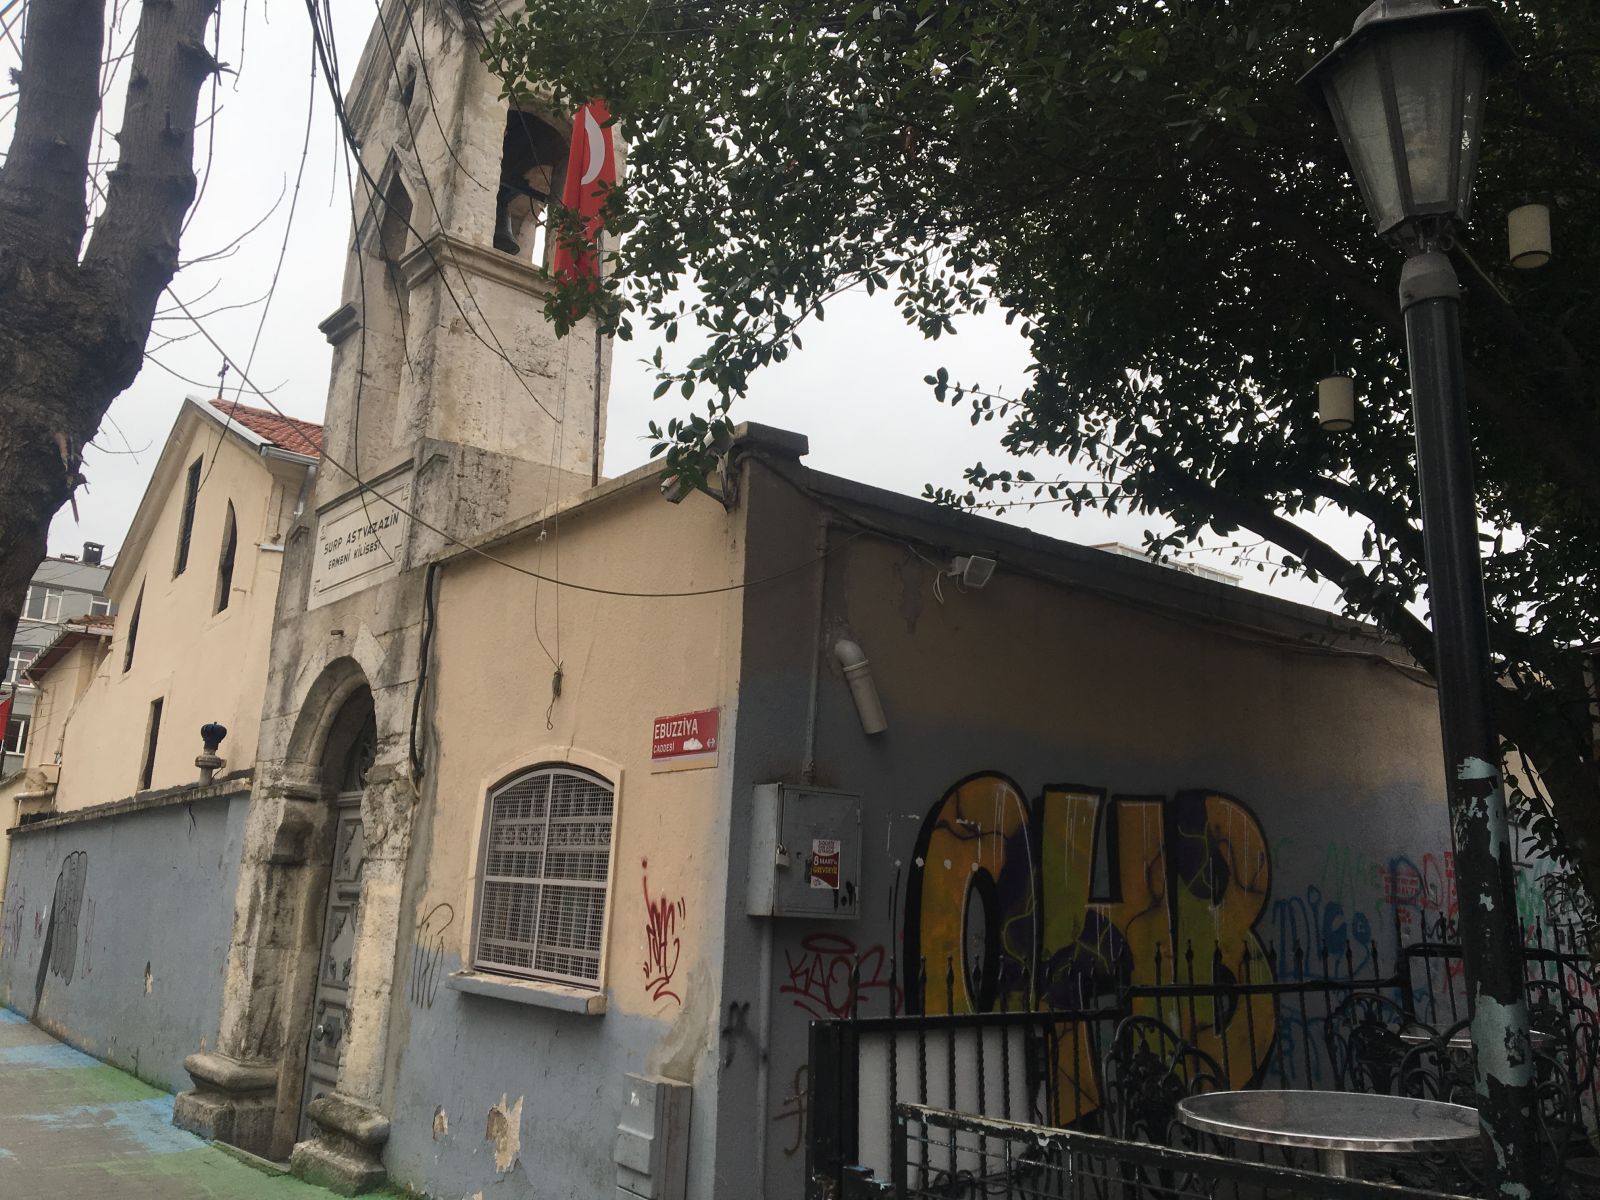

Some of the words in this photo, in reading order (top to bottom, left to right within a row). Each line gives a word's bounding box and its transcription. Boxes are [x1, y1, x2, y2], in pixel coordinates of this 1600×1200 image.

[324, 537, 343, 555] SURP
[654, 718, 698, 740] EBUZZİYA
[653, 741, 675, 753] CADDESİ
[813, 855, 819, 866] 8
